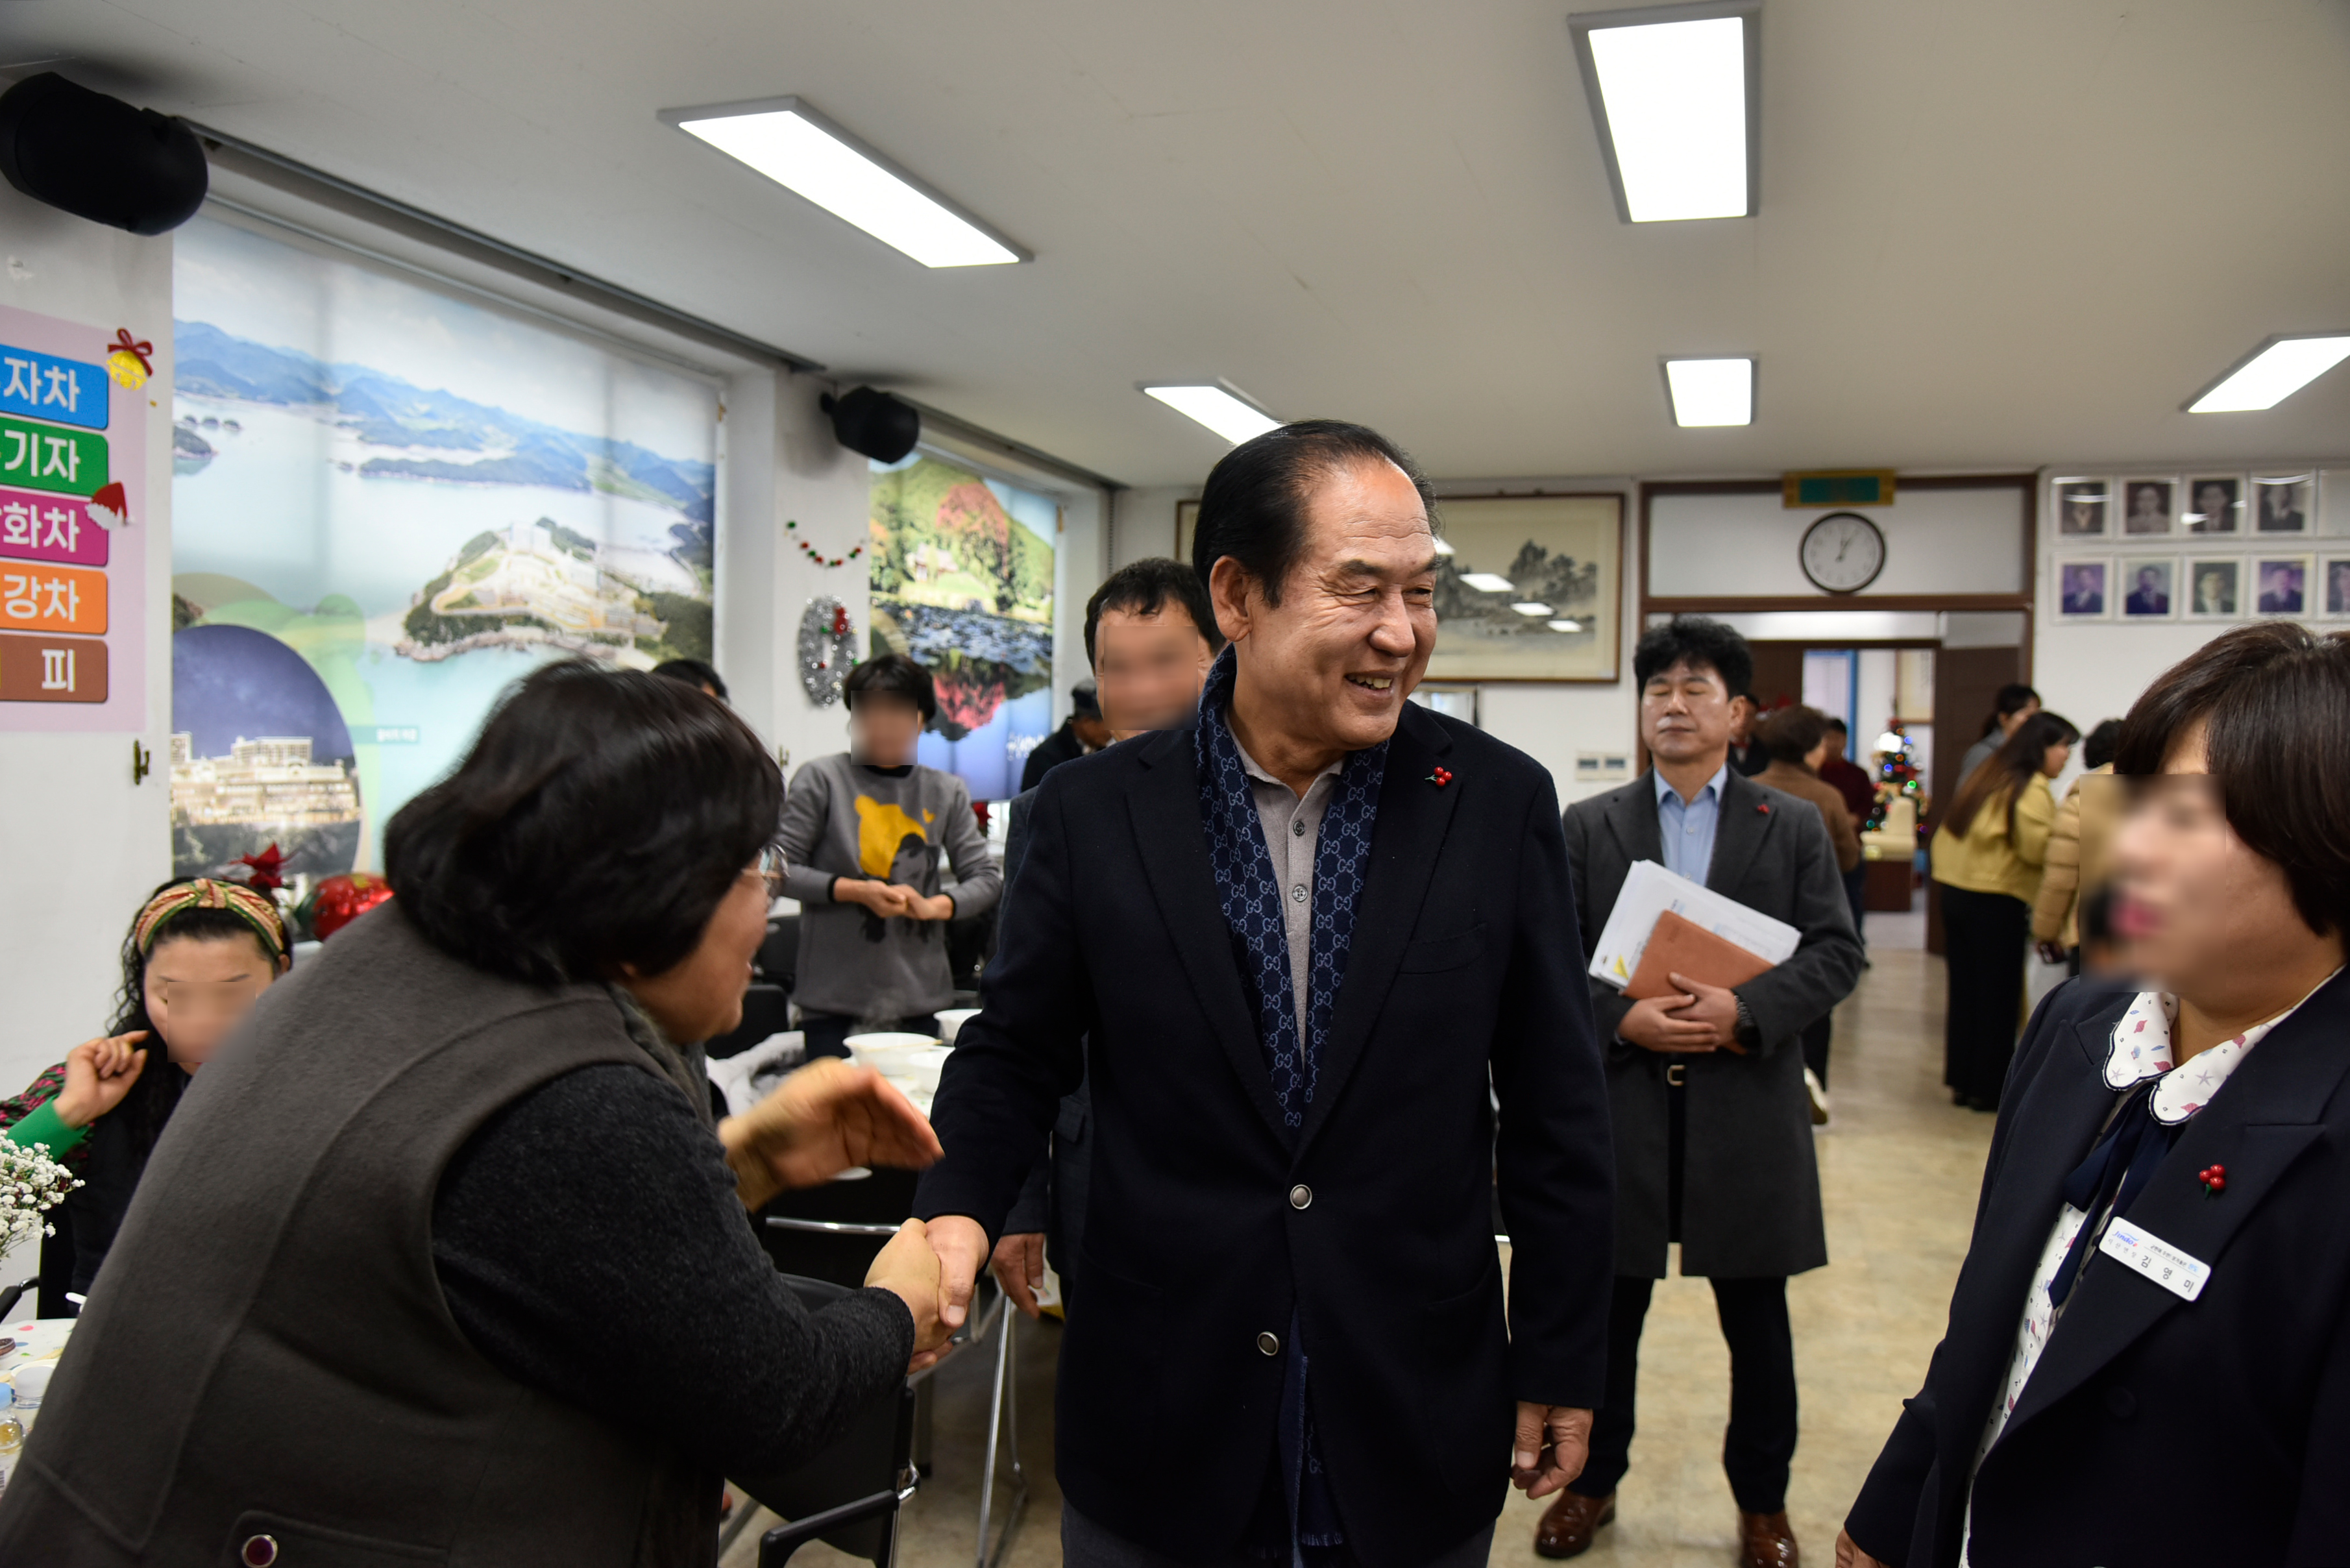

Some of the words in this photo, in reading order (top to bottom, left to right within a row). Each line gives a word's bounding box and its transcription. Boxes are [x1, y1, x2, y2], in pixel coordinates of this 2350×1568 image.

[0, 357, 80, 413] 자차
[0, 429, 80, 483] 기자
[0, 501, 80, 552] 화차
[0, 574, 80, 622] 강차
[42, 649, 75, 692] 피
